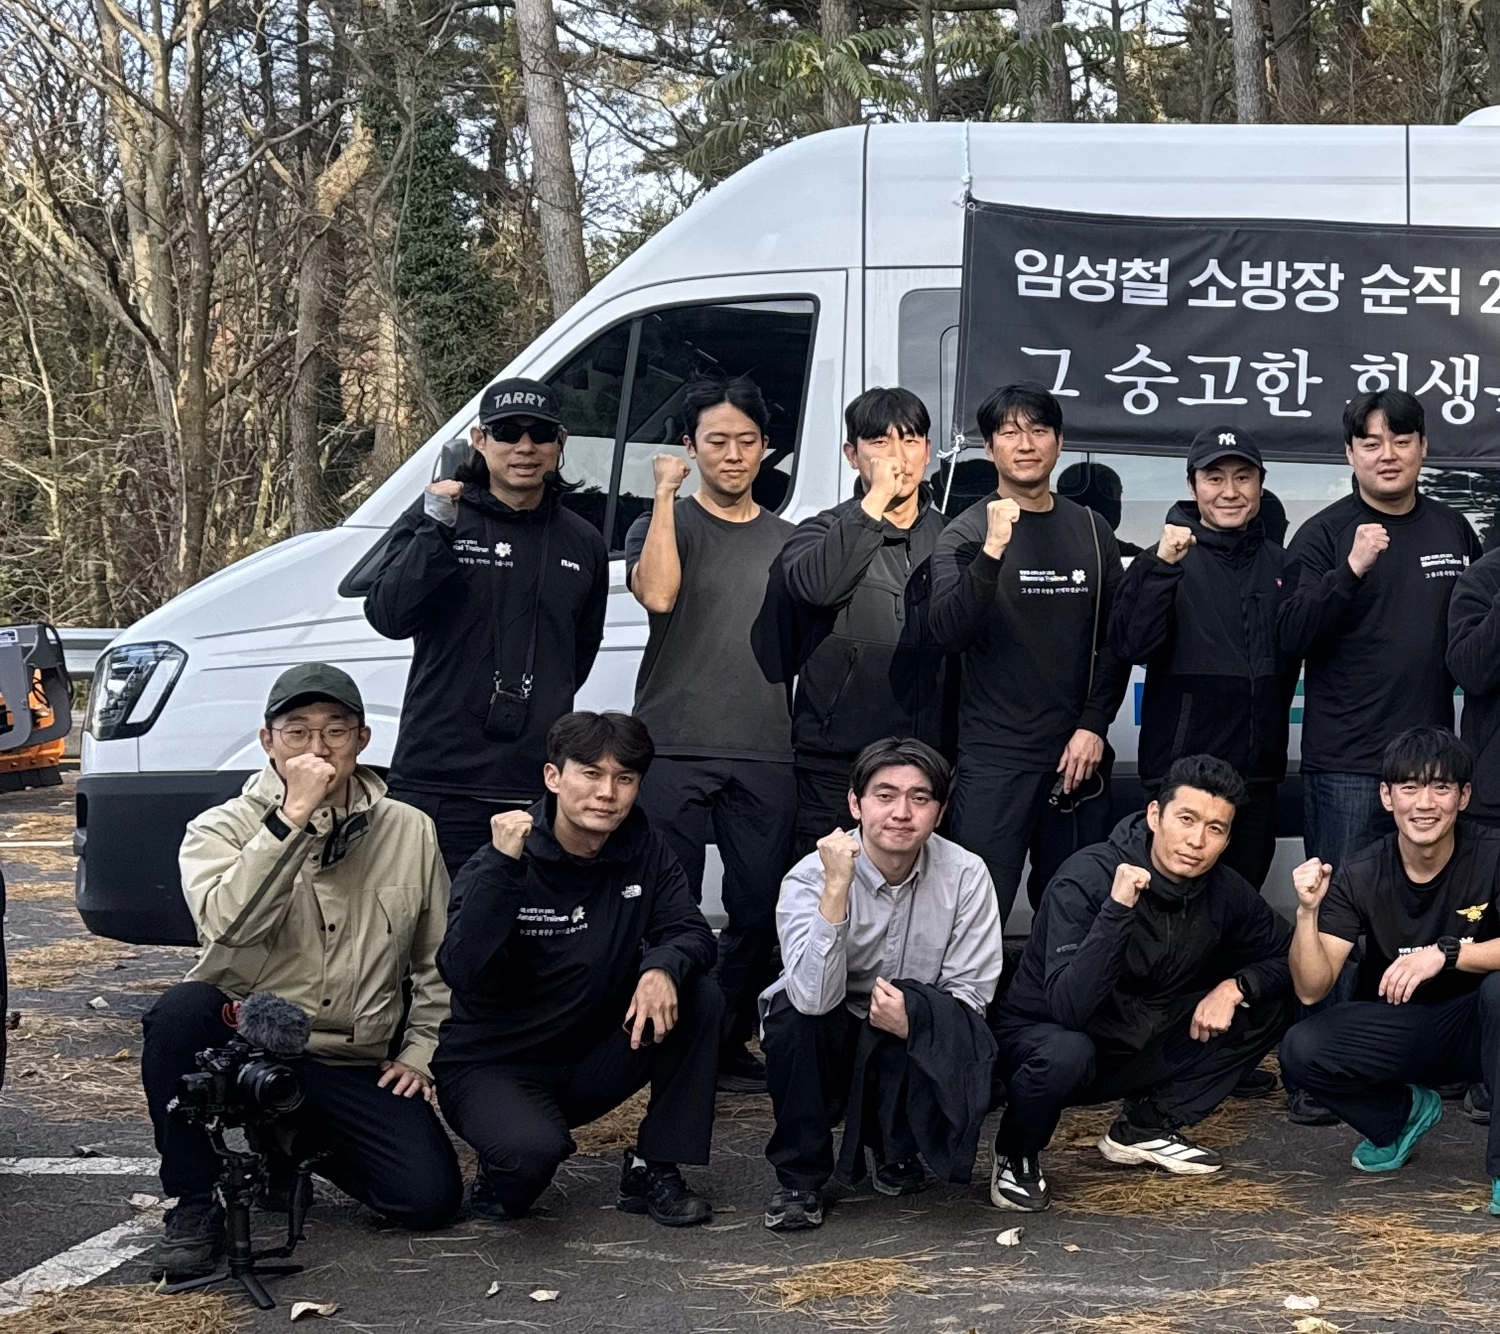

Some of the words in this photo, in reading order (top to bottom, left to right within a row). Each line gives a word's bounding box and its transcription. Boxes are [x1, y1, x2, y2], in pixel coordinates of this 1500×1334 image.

[1014, 248, 1170, 306] 임성철
[1188, 259, 1344, 313] 소방장
[1361, 263, 1462, 316] 순직
[494, 392, 546, 409] TARRY
[1020, 347, 1080, 397] 그
[1104, 344, 1323, 418] 숭고한
